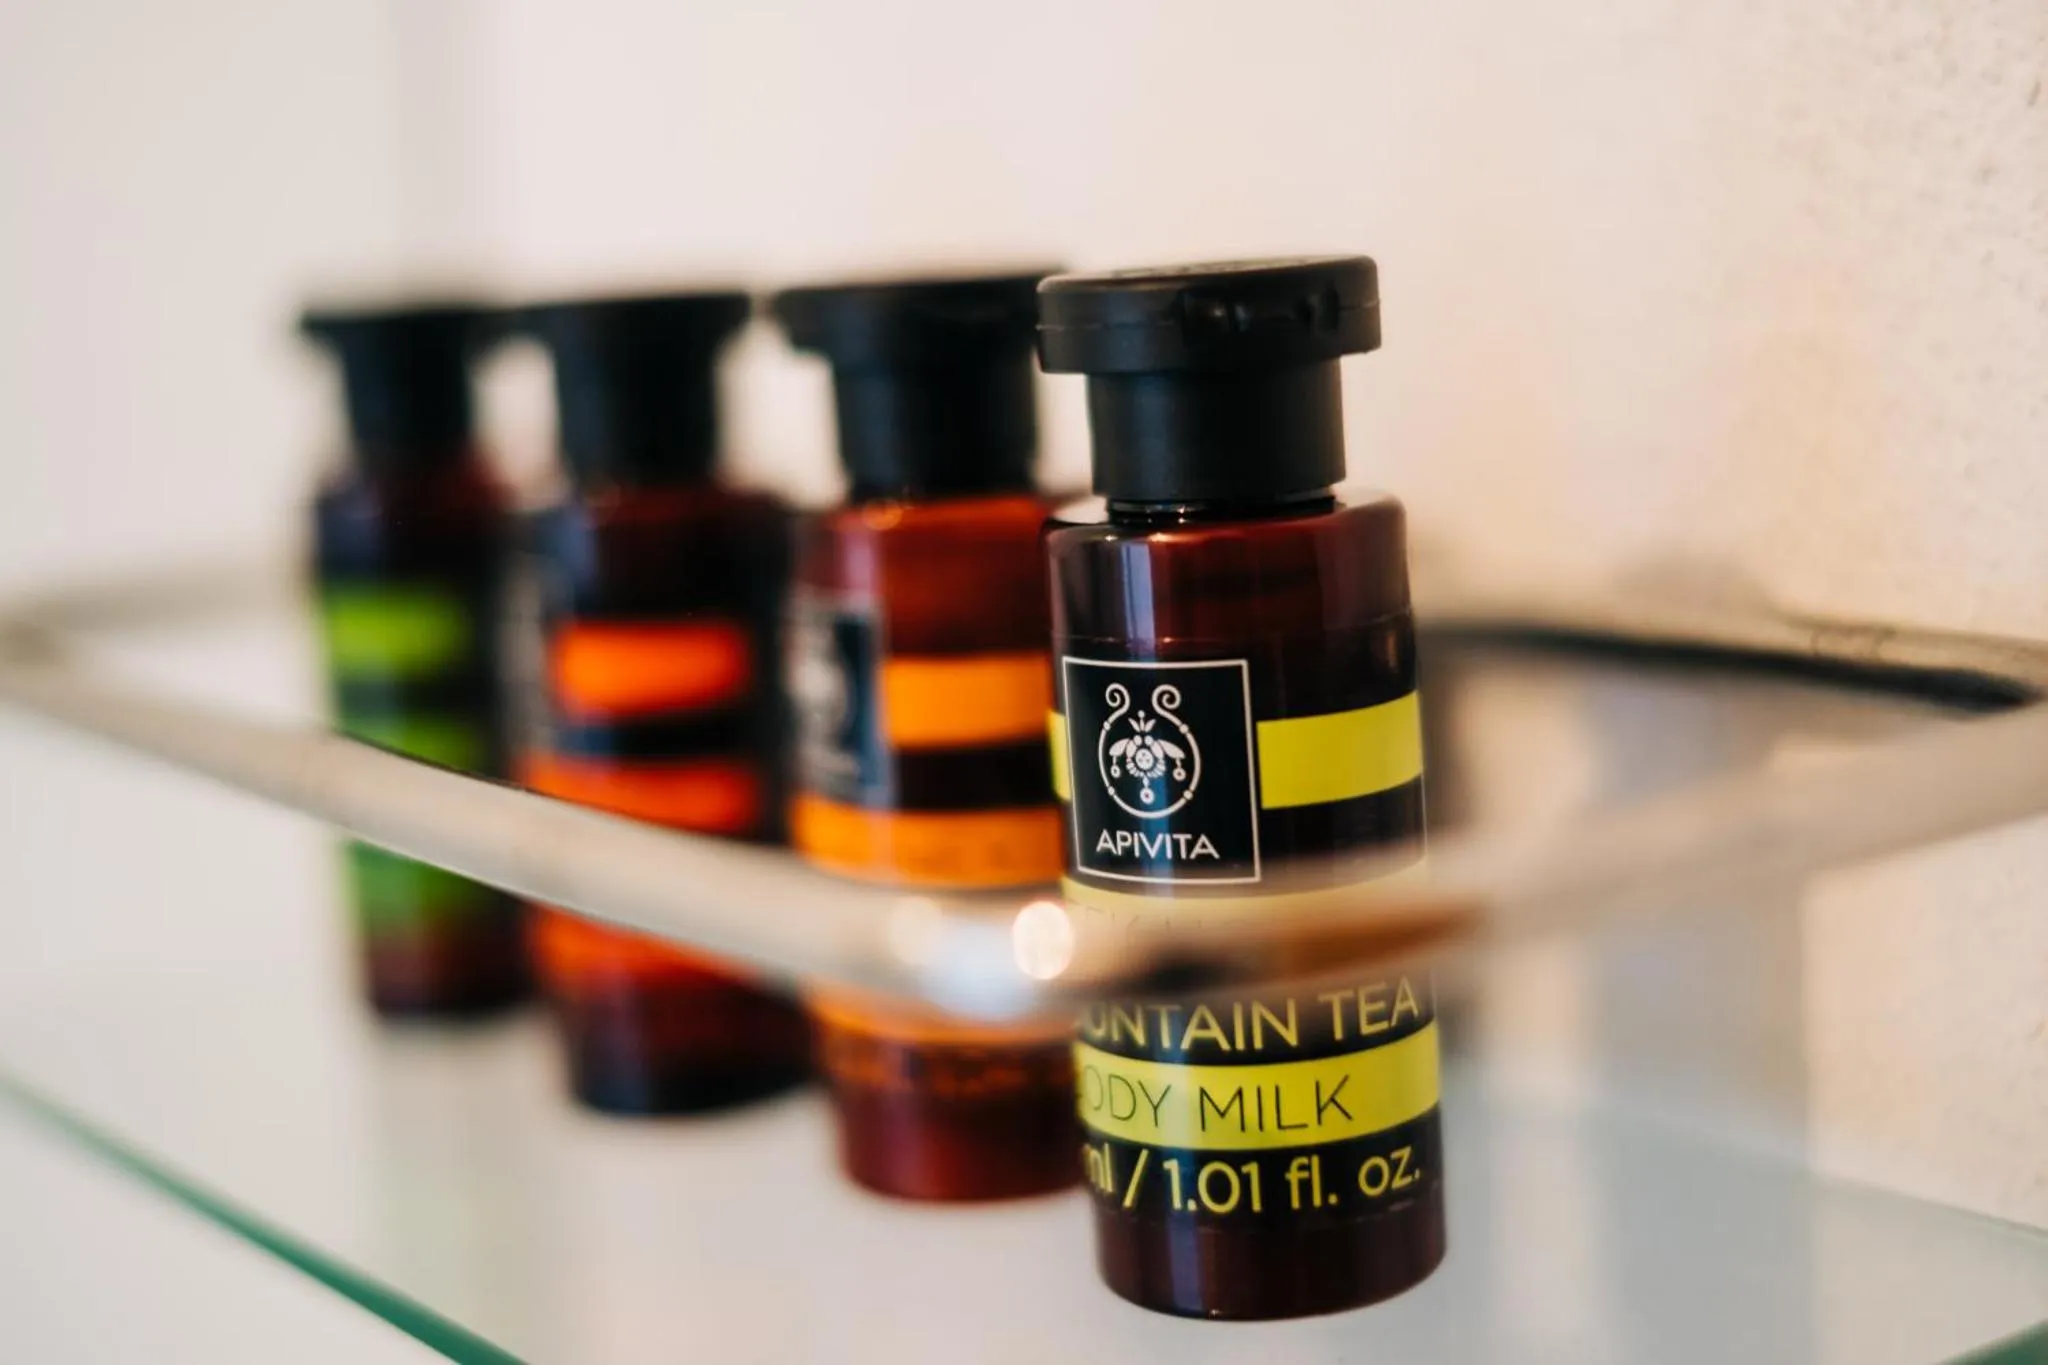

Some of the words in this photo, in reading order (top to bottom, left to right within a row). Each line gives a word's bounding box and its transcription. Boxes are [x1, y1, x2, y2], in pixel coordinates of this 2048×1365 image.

[1096, 829, 1220, 860] APIVITA
[1074, 999, 1298, 1051] UNTAIN
[1318, 975, 1420, 1041] TEA
[1200, 1074, 1353, 1133] MILK
[1122, 1148, 1149, 1209] /
[1162, 1158, 1262, 1214] 1.01
[1285, 1154, 1338, 1210] fl.
[1358, 1146, 1421, 1196] oz.
